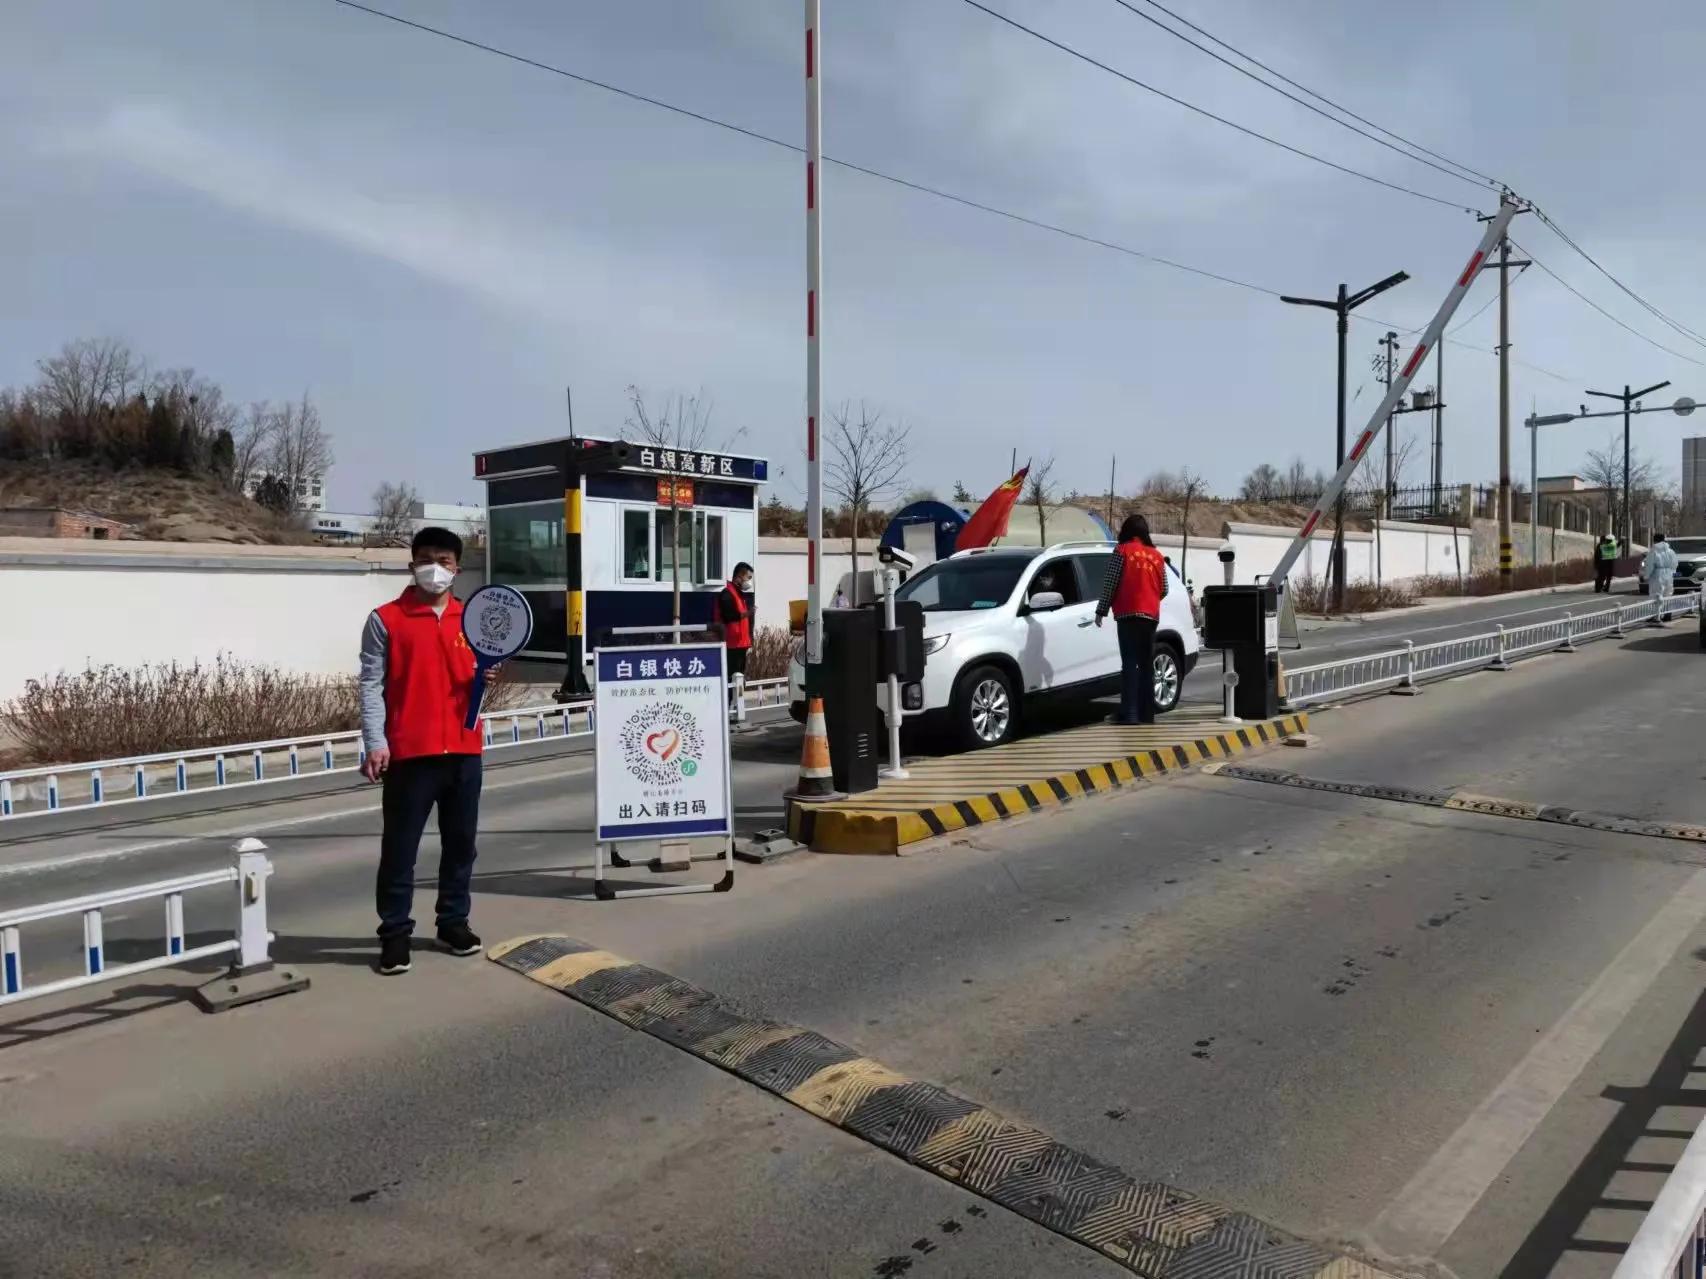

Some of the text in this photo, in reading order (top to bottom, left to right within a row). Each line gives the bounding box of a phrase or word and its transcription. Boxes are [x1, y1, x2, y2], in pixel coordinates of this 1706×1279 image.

[640, 448, 734, 476] 白银高新区
[616, 657, 706, 678] 白银快办
[619, 800, 706, 818] 出入请扫码
